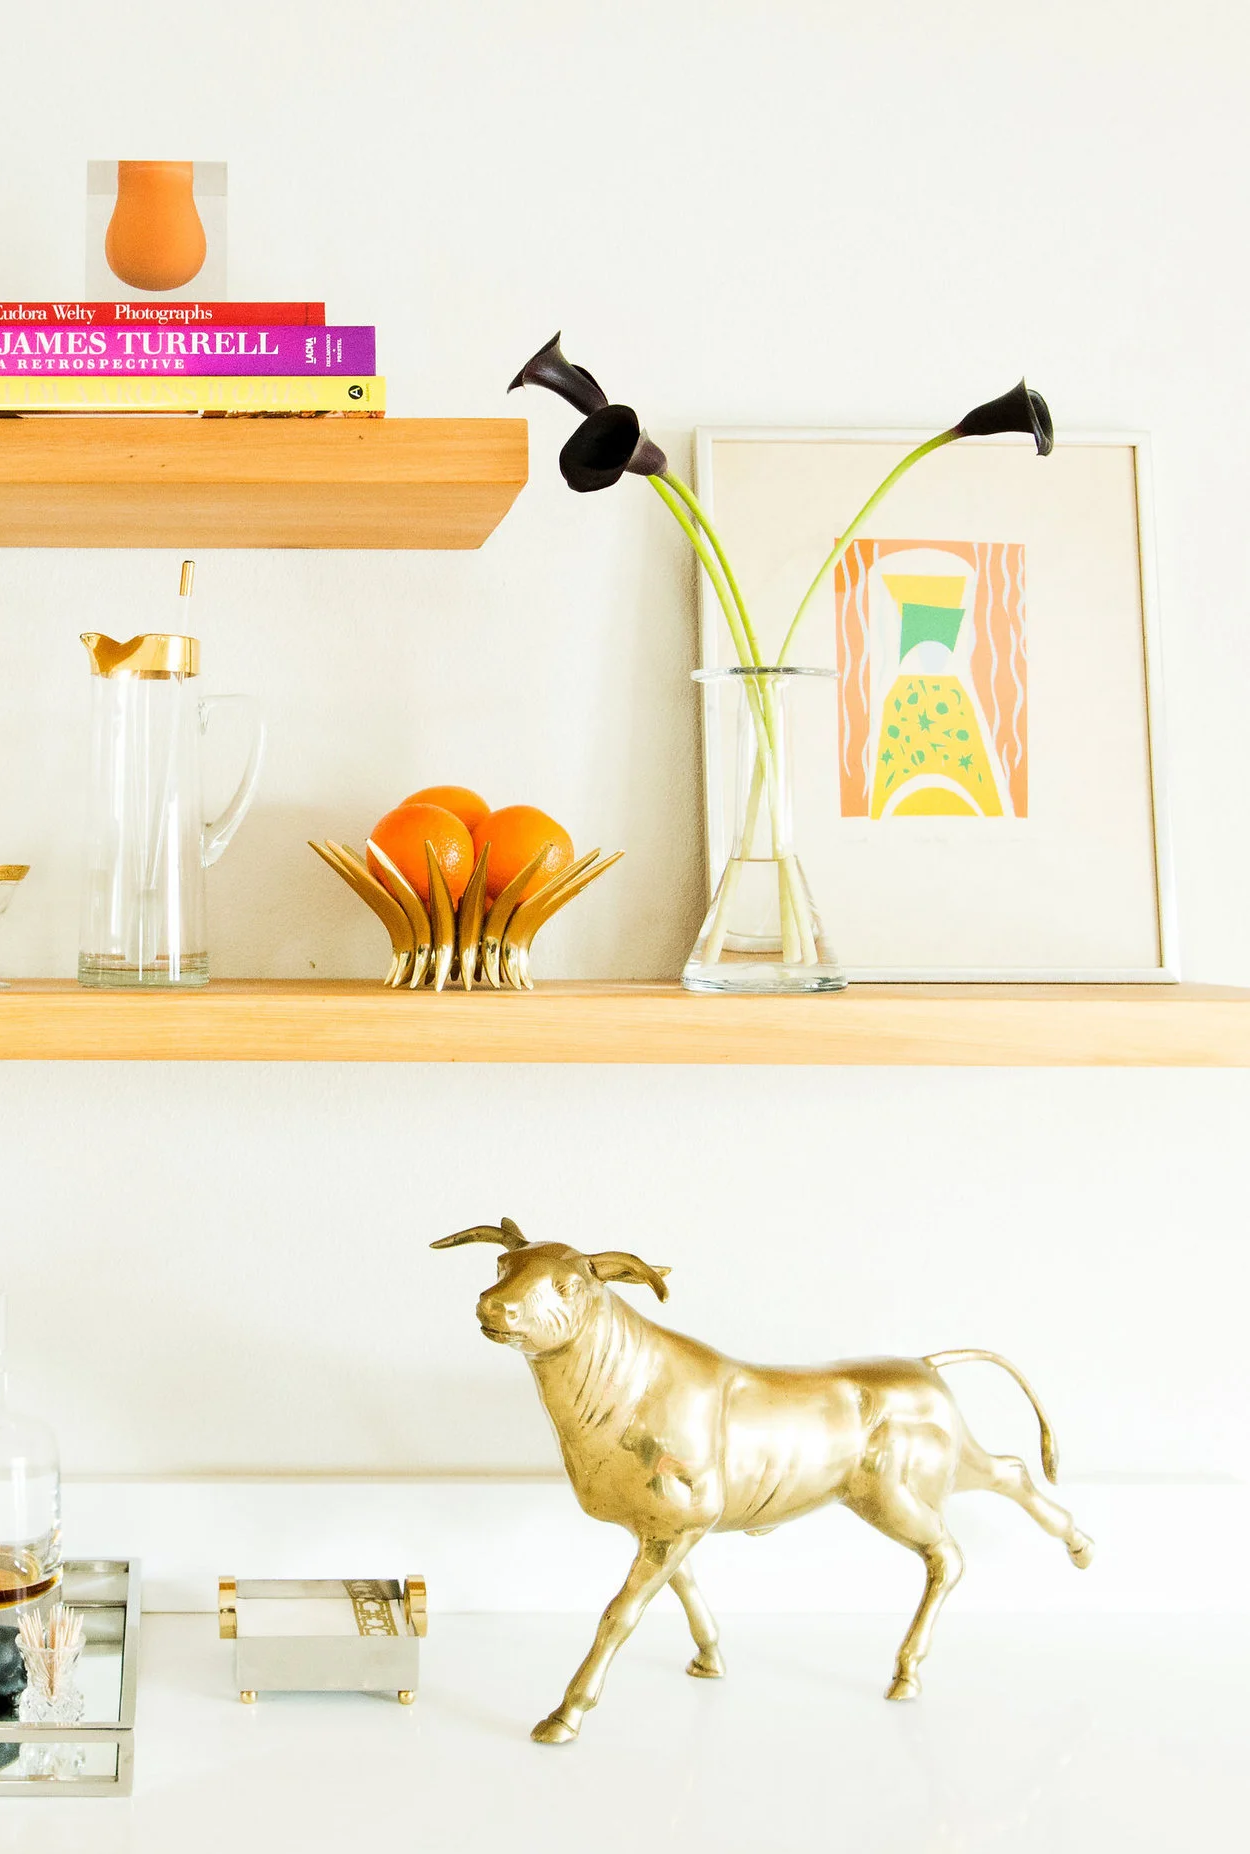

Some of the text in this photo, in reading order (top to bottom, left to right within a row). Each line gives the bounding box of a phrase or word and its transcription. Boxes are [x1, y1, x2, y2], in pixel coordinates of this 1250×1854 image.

[53, 305, 96, 325] Welty
[114, 304, 213, 325] Photographs
[117, 332, 279, 355] TURRELL
[18, 358, 186, 369] RETROSPECTIVE
[349, 386, 362, 398] A
